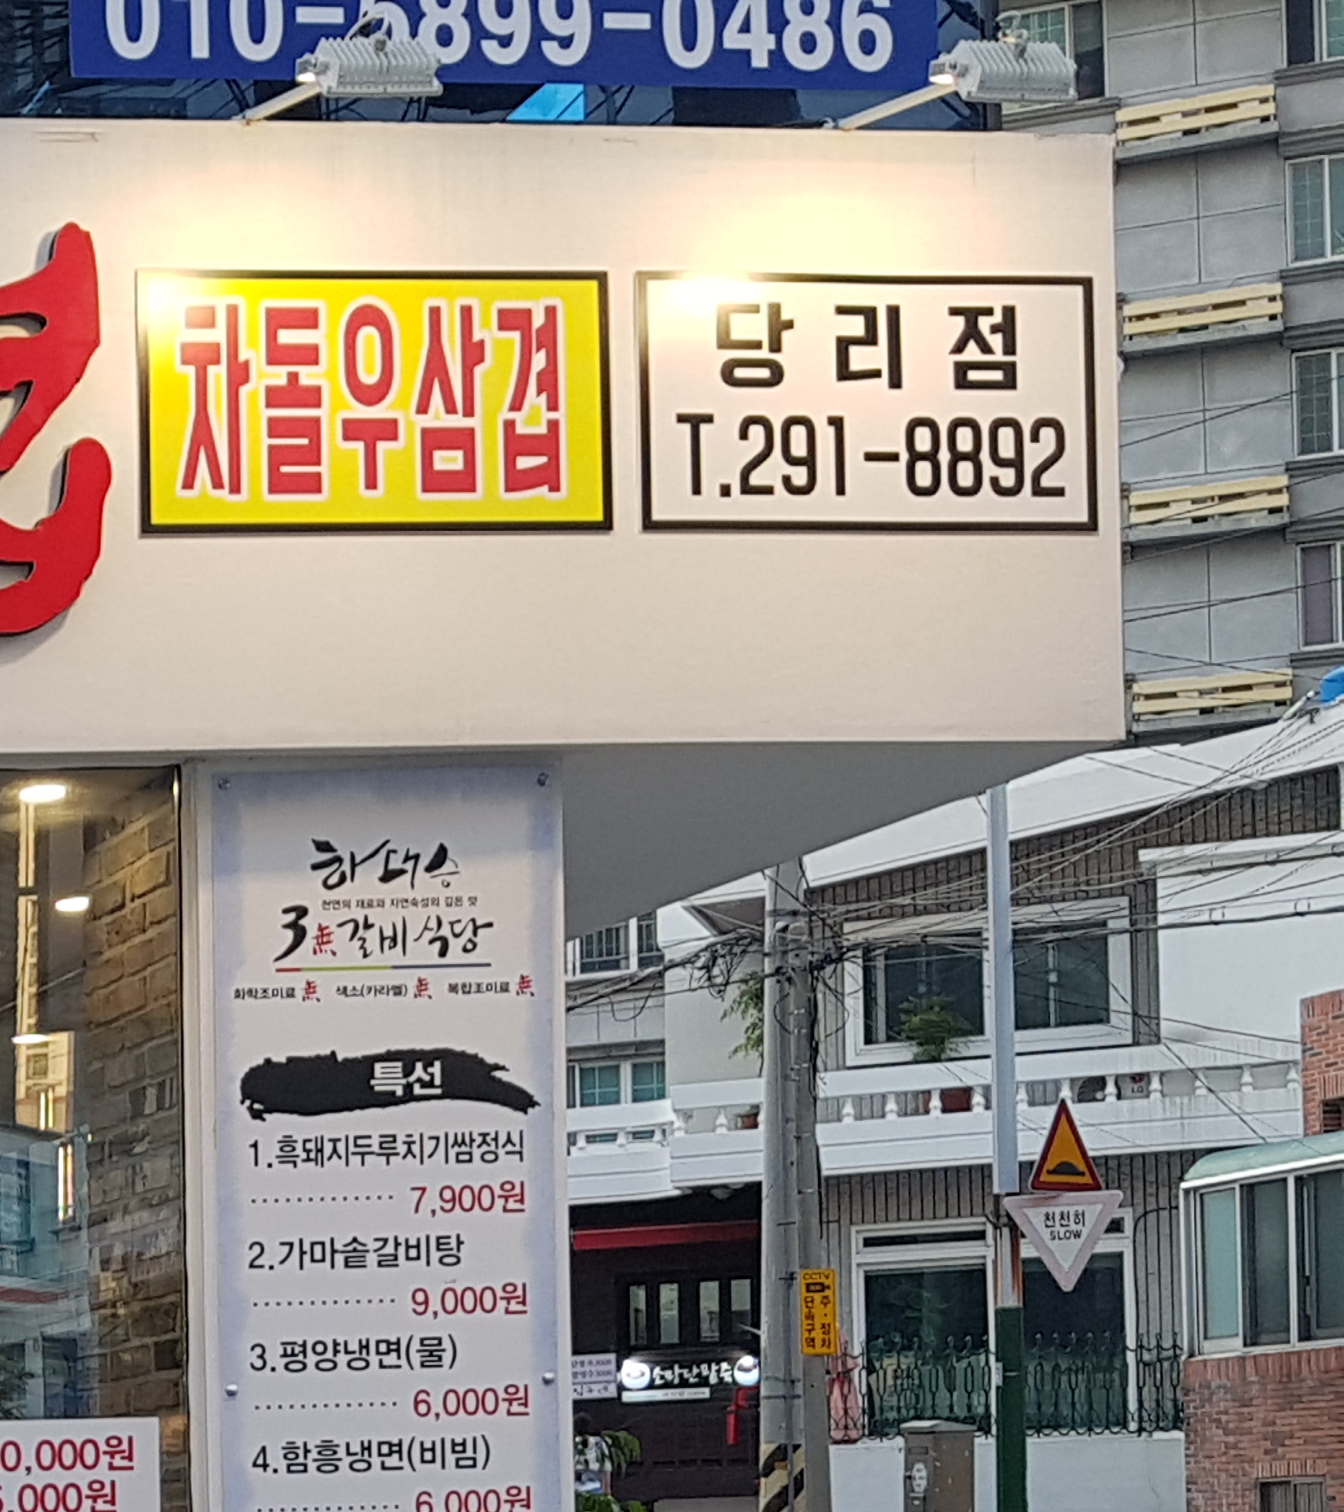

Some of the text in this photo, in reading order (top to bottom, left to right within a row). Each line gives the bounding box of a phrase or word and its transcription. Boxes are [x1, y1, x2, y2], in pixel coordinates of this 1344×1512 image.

[180, 301, 564, 498] 차돌우삼겹
[677, 413, 1066, 500] T.291-8892
[370, 1060, 443, 1096] 특선
[249, 1130, 525, 1168] 1.흑돼지두루치기쌈정식
[410, 1180, 526, 1218] 7,900원
[1043, 1209, 1086, 1228] 천천히
[1049, 1229, 1082, 1241] SLOW
[248, 1233, 465, 1271] 2.가마솥갈비탕
[411, 1282, 528, 1319] 9,000원
[250, 1334, 458, 1372] 3.평양냉면(물)
[413, 1384, 530, 1421] 6,000원
[252, 1434, 491, 1474] 4.함흥냉면(비빔)
